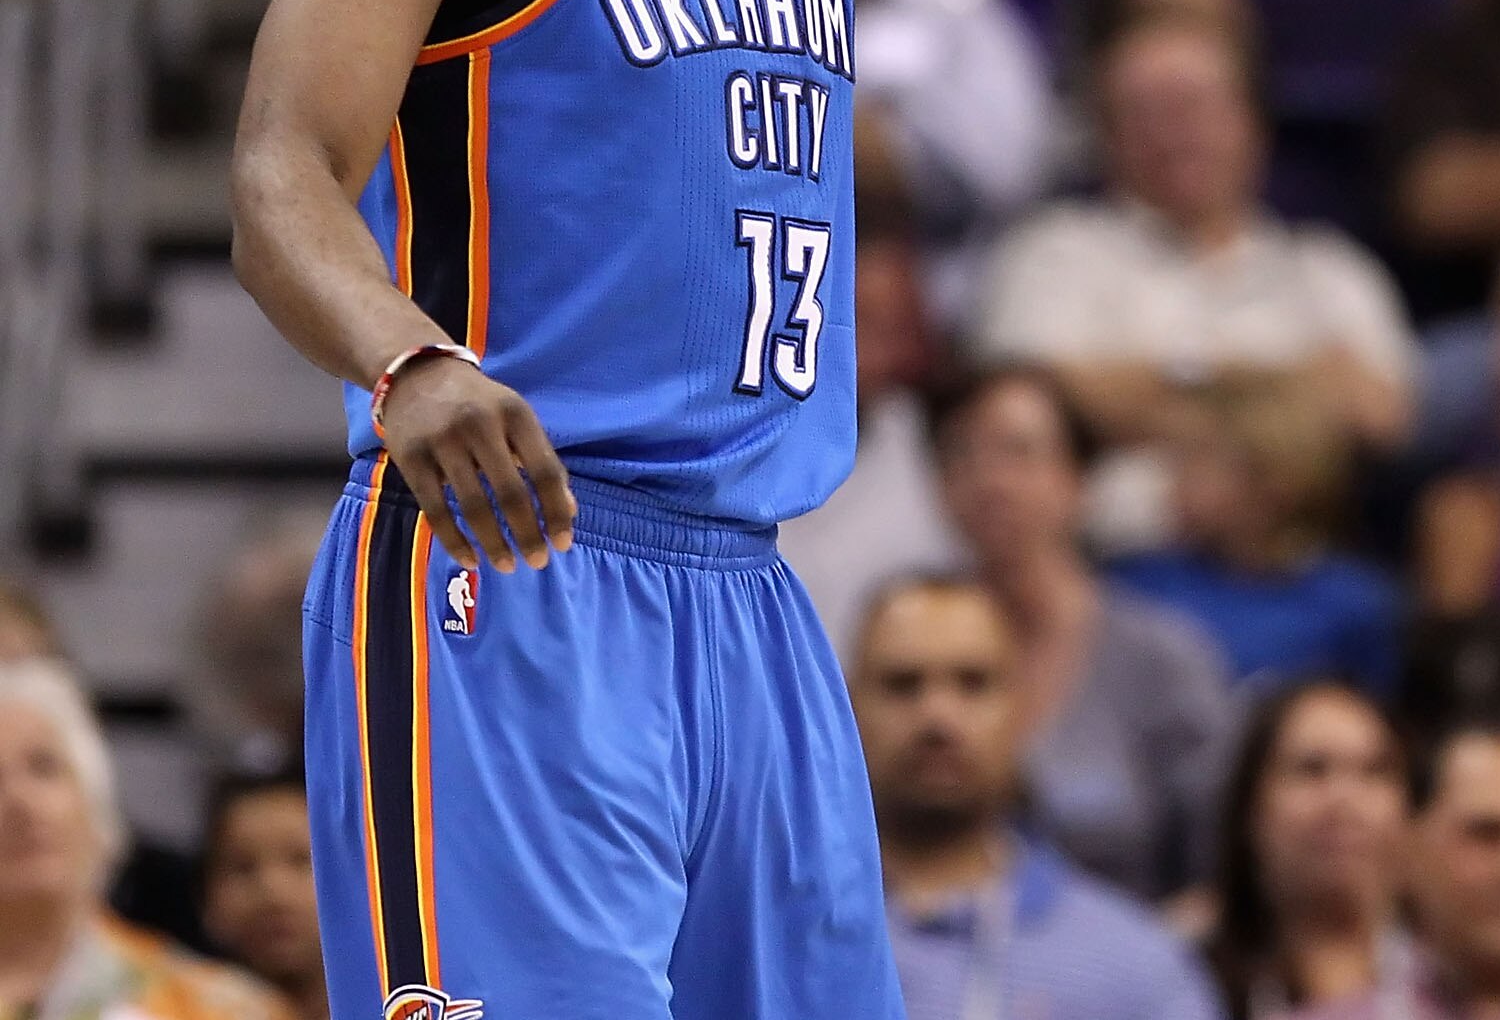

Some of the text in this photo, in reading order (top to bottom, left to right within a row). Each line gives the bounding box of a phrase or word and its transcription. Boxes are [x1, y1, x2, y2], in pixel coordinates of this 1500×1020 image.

[727, 70, 829, 182] CITY
[732, 209, 831, 401] 13
[444, 619, 464, 632] NBA
